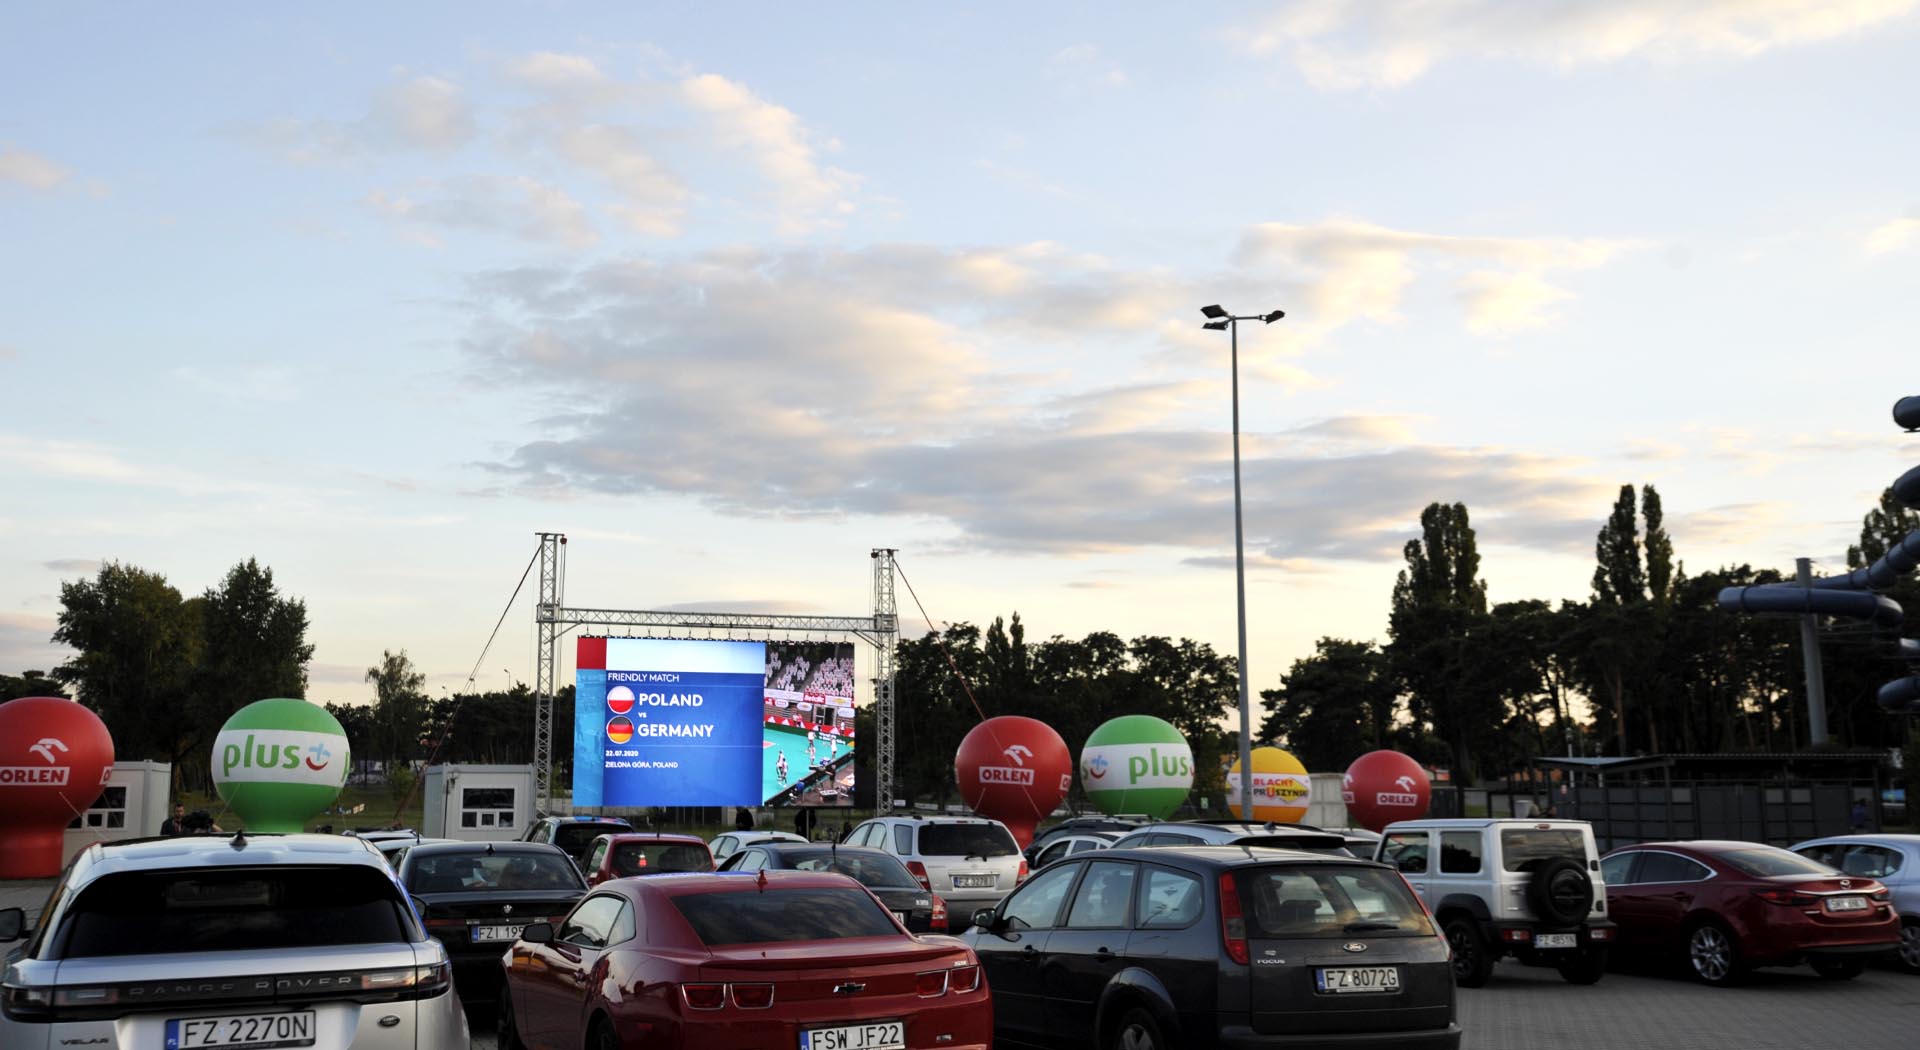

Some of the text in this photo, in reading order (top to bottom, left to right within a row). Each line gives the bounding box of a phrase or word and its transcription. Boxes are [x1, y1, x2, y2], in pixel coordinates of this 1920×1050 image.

[607, 672, 680, 682] FRIENDLY MATCH
[639, 693, 703, 707] POLAND
[637, 723, 714, 737] GERMANY
[223, 734, 301, 777] plus
[1128, 748, 1189, 785] plus
[0, 769, 65, 783] ORLEN
[982, 769, 1031, 783] ORLEN
[1379, 794, 1415, 804] ORLEN
[1325, 968, 1397, 988] FZ 8072G
[128, 976, 352, 996] RANGE ROVER
[184, 1015, 308, 1046] FZ 2270N
[812, 1025, 900, 1050] FSW JF22
[59, 1037, 110, 1046] VELAR
